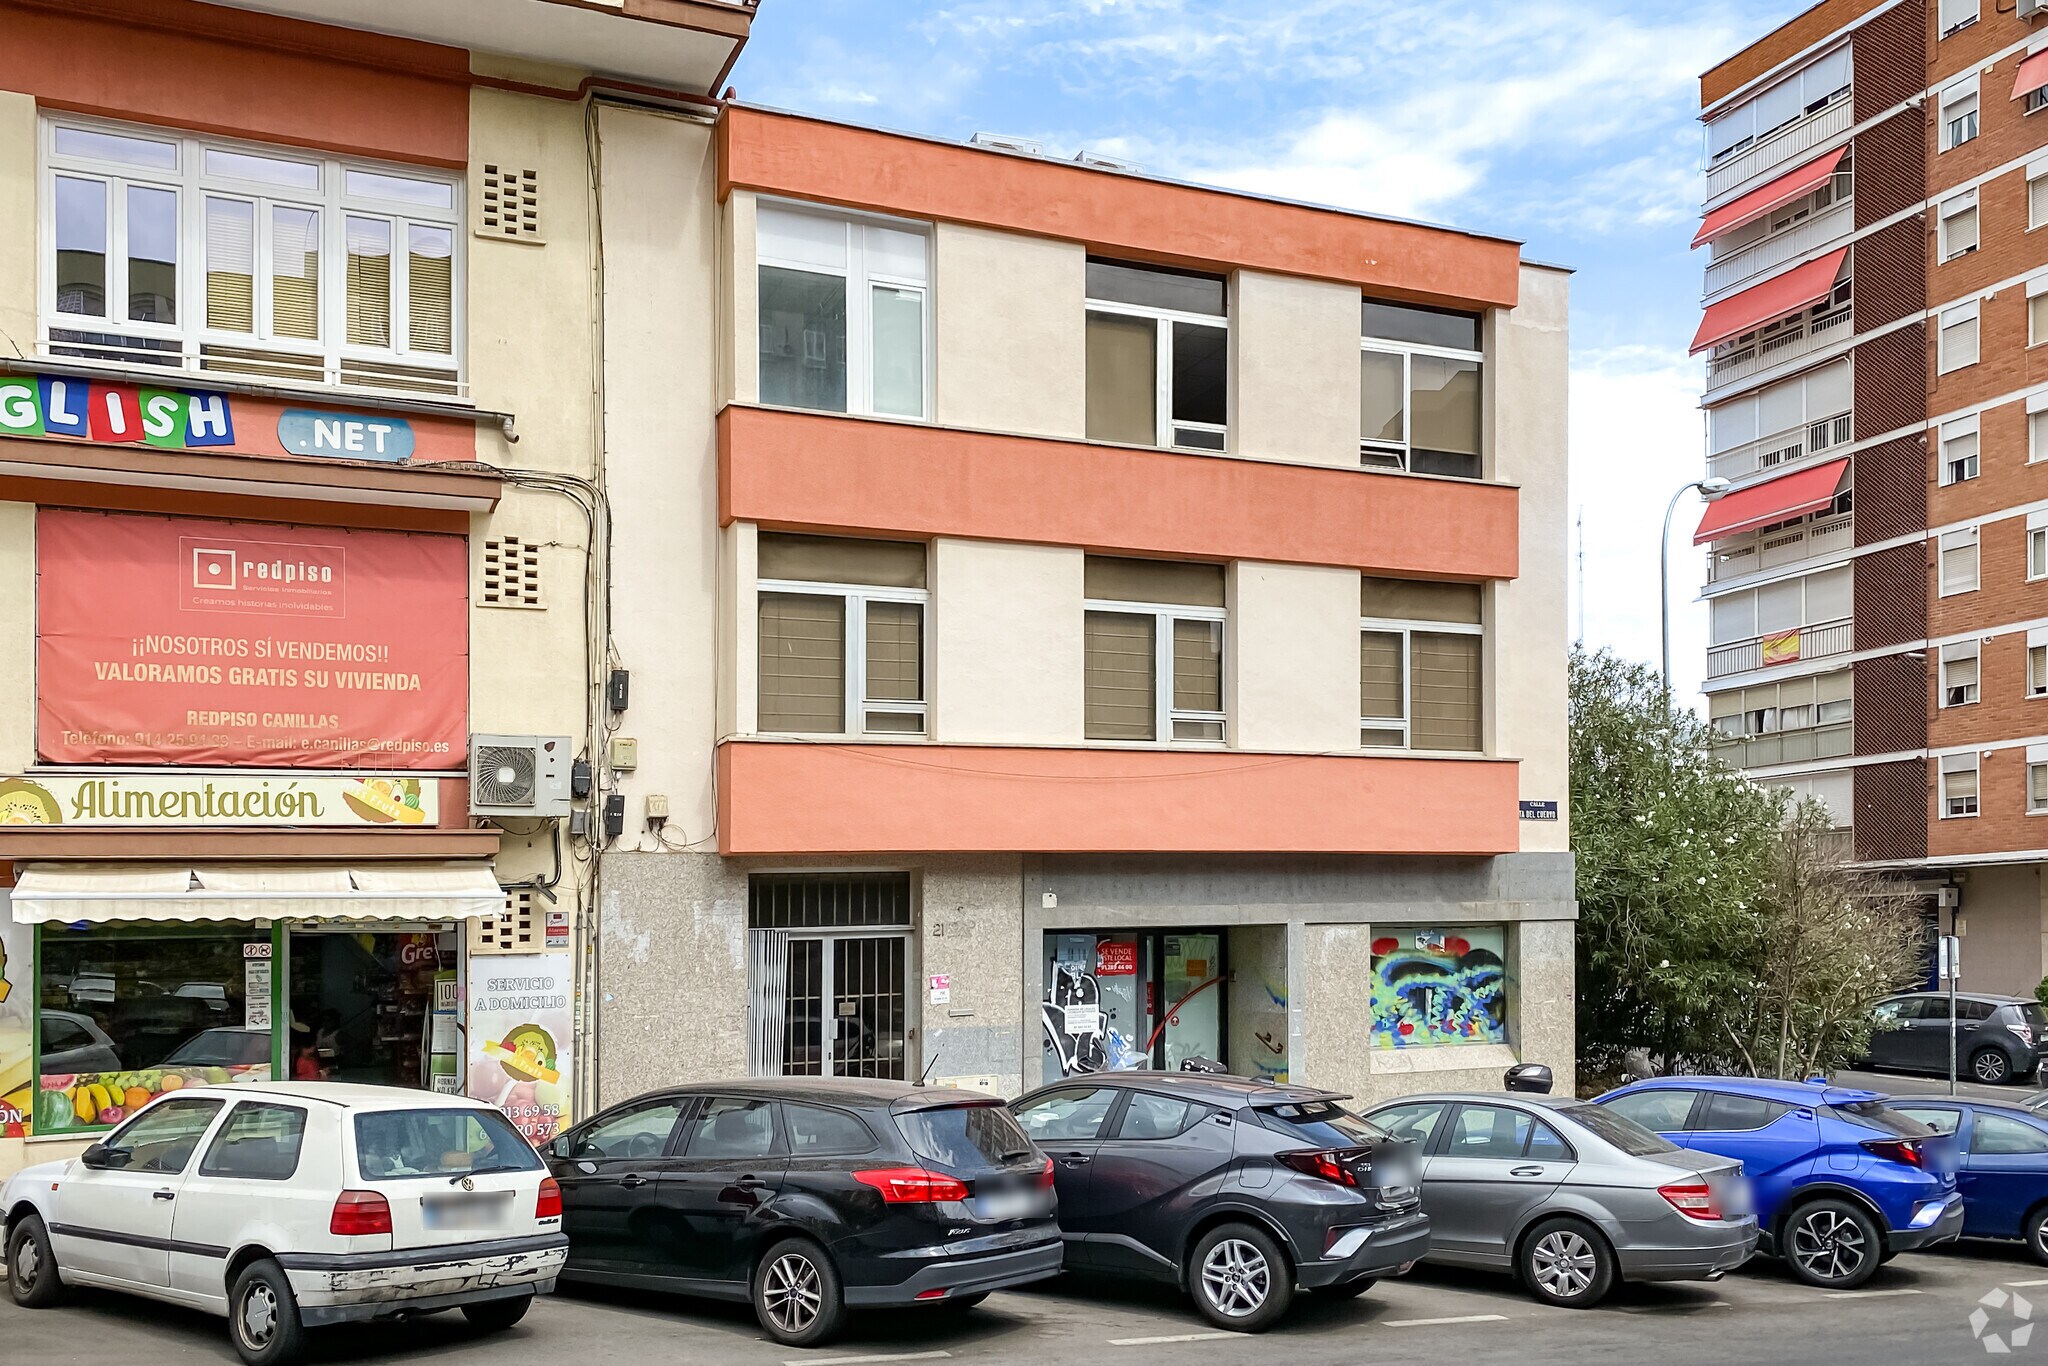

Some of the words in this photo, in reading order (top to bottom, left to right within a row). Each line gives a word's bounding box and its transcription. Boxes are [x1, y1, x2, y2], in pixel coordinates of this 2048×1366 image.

[300, 418, 392, 453] .NET
[243, 560, 332, 584] redpiso
[192, 596, 236, 607] Creamos
[237, 599, 277, 609] historias
[279, 601, 334, 612] inolvidables
[132, 634, 249, 657] ¡¡NOSOTROS
[254, 637, 272, 659] SÍ
[276, 640, 389, 663] VENDEMOS!!
[95, 662, 222, 685] VALORAMOS
[228, 666, 298, 687] GRATIS
[303, 671, 329, 688] SU
[335, 671, 422, 692] VIVIENDA
[187, 710, 257, 728] REDPISO
[262, 712, 339, 730] CANILLAS
[166, 733, 185, 747] 25
[246, 735, 297, 750] E-mail:
[301, 737, 450, 755] e.canillas@redpiso.es
[71, 780, 325, 819] Alimentación
[369, 795, 401, 817] Fruta
[1536, 810, 1556, 818] CUERVO
[932, 923, 945, 937] 21
[1110, 947, 1132, 955] VENDE
[1114, 954, 1133, 962] LOCAL
[487, 977, 555, 992] SERVICIO
[474, 997, 488, 1012] A
[489, 995, 567, 1011] DOMICILIO
[523, 1105, 540, 1118] 69
[543, 1103, 560, 1116] 58
[536, 1122, 560, 1136] 573
